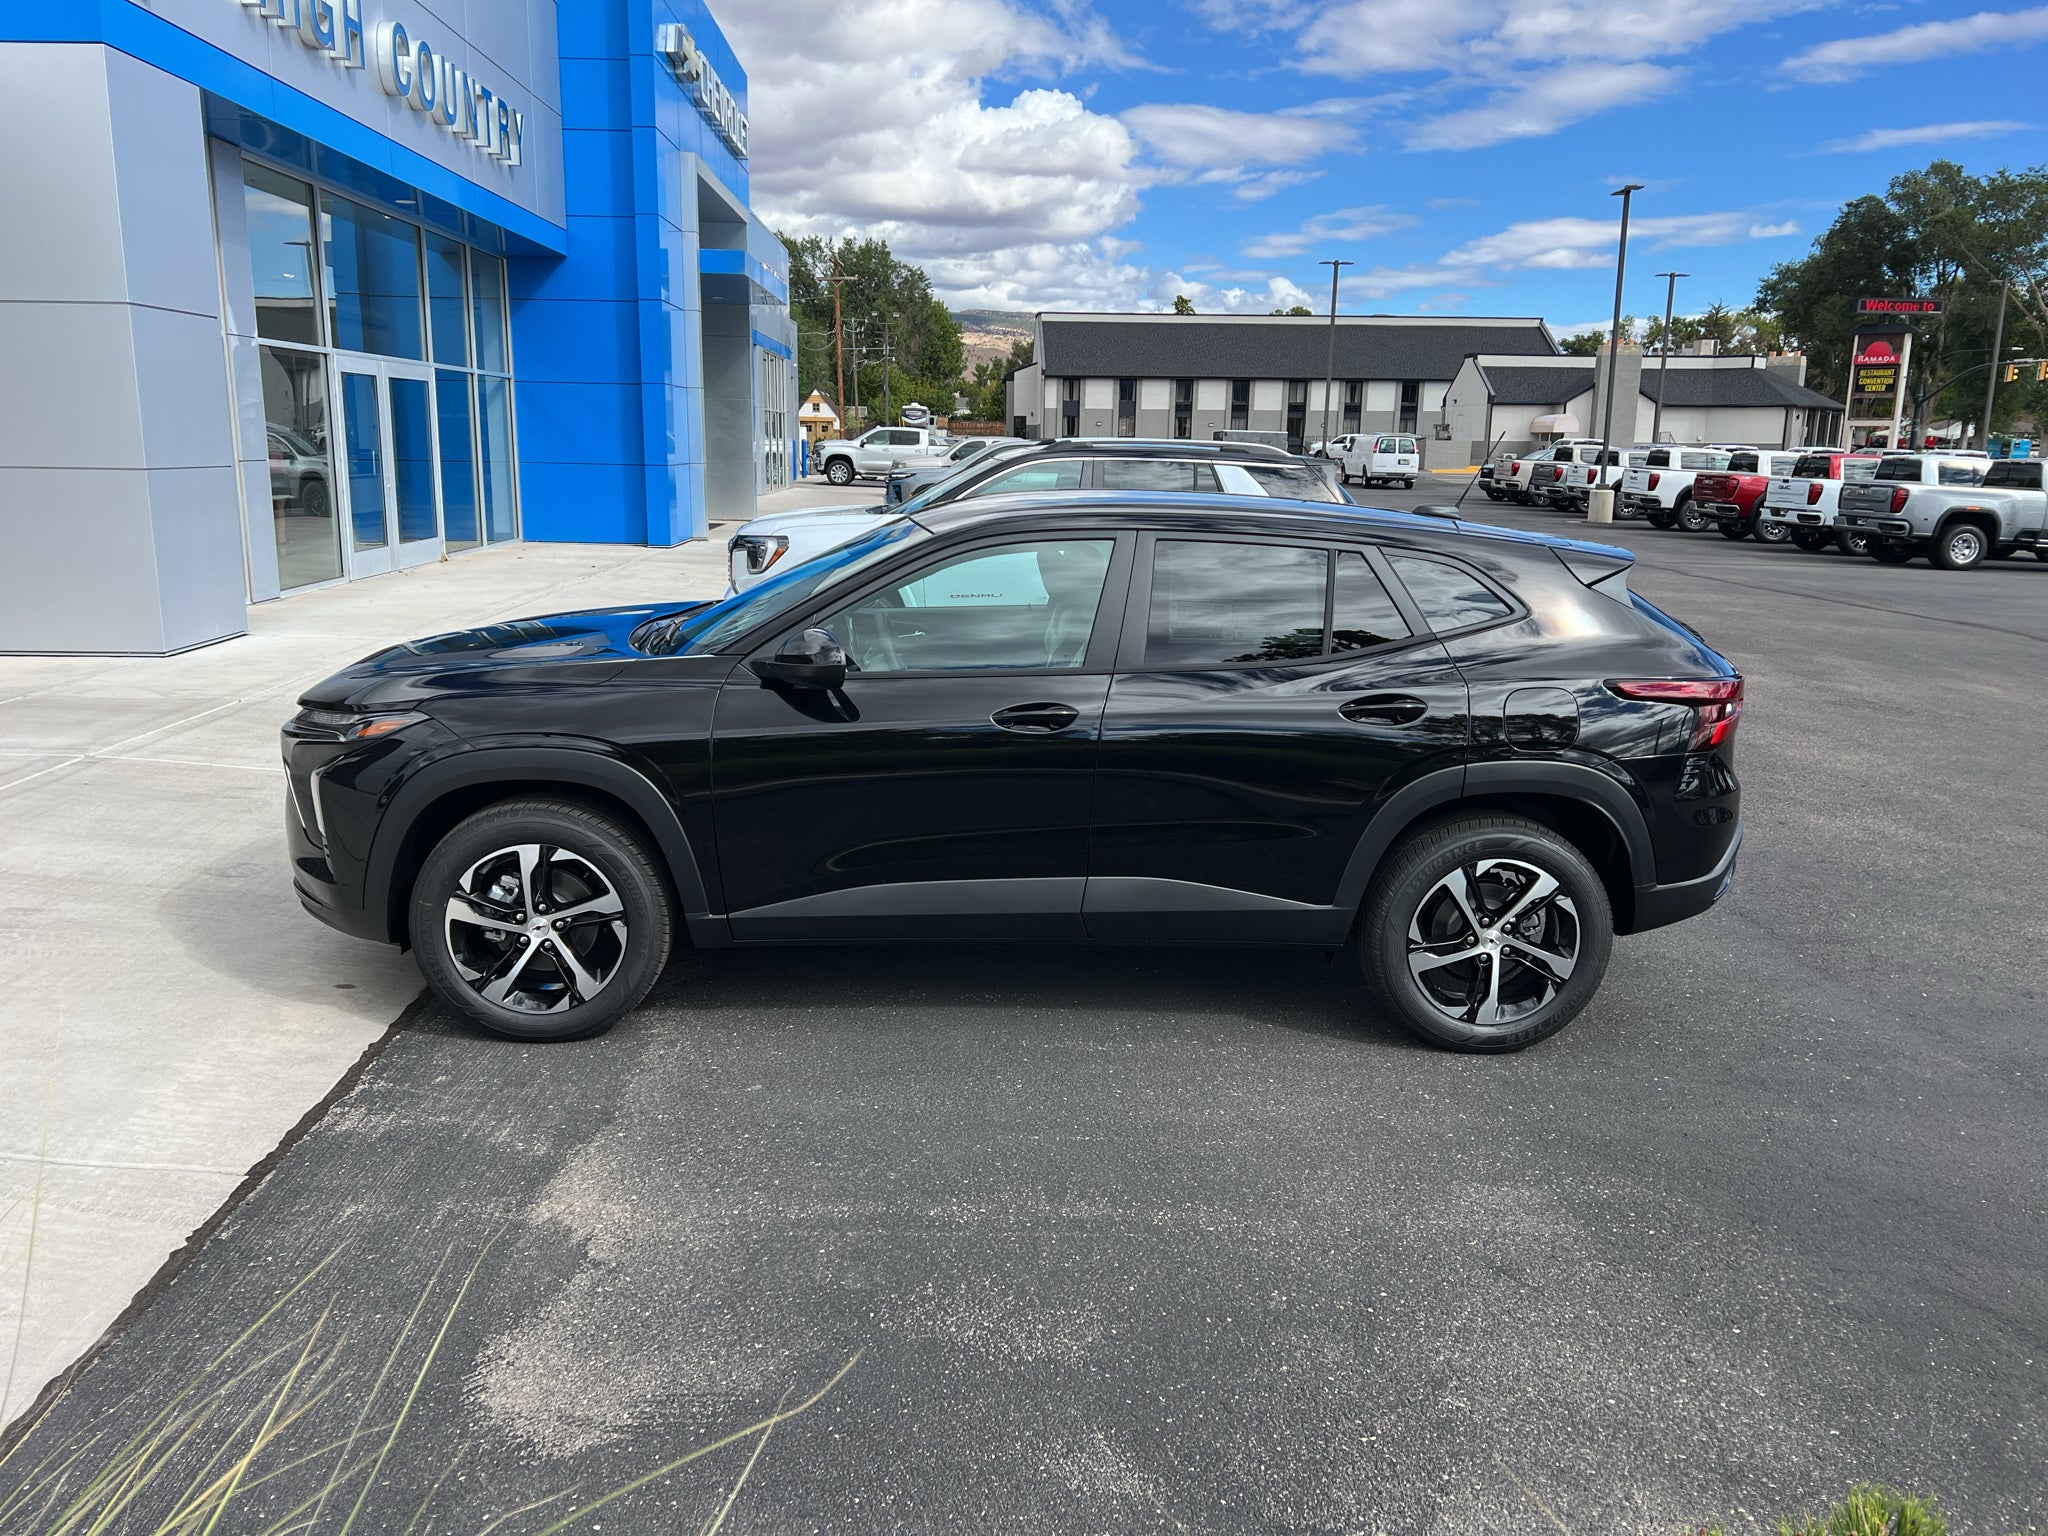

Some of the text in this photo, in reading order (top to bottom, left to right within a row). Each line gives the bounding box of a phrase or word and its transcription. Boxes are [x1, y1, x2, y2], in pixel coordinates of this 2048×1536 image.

[376, 21, 524, 166] COUNTRY
[1865, 299, 1935, 311] Welcome to
